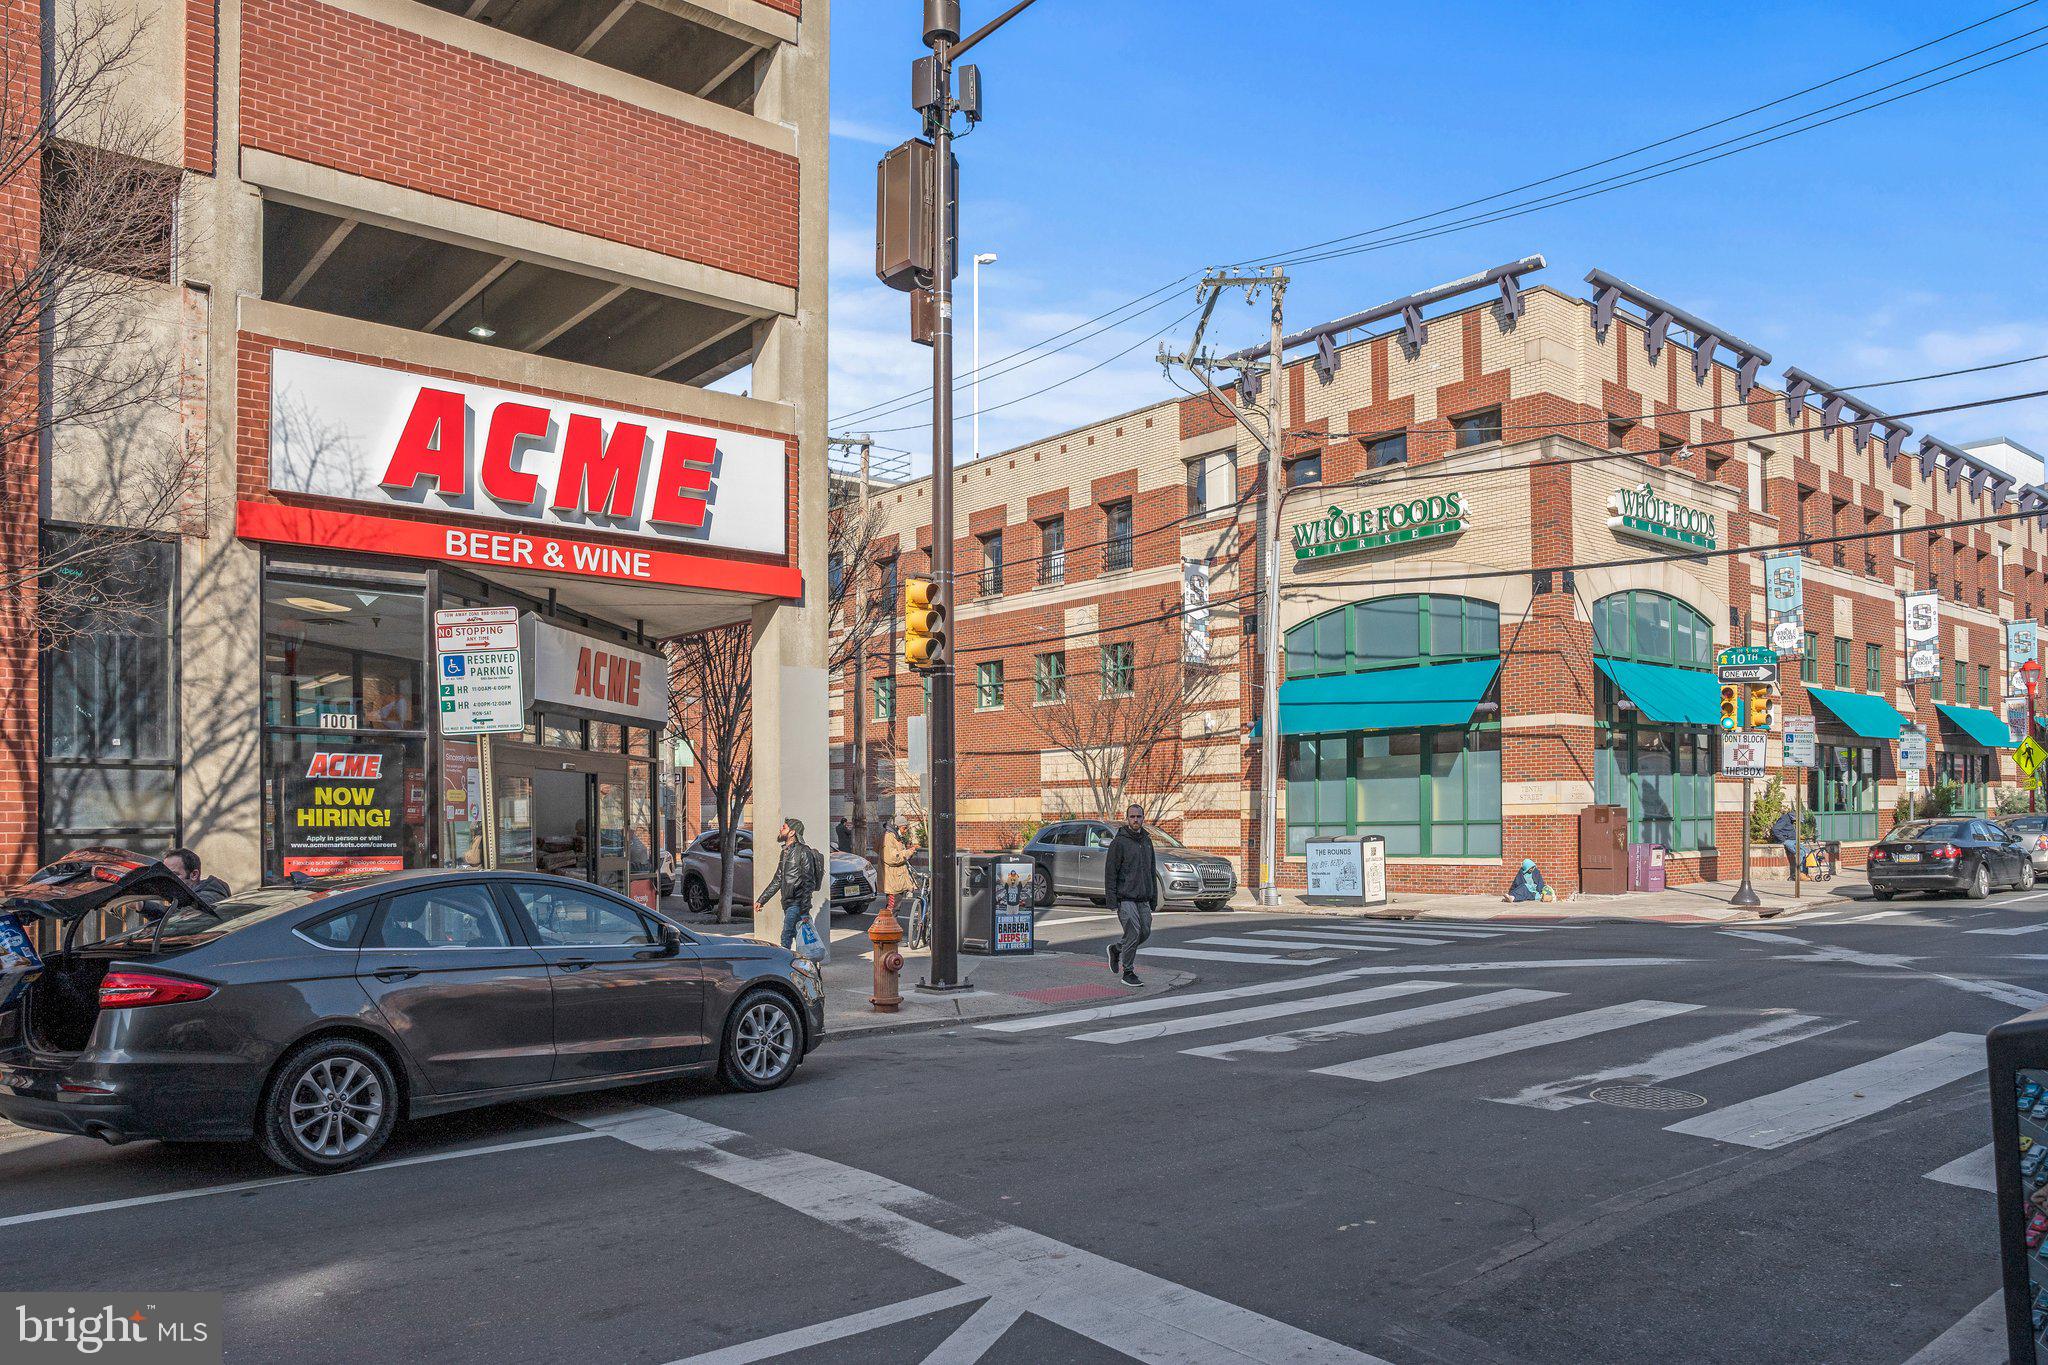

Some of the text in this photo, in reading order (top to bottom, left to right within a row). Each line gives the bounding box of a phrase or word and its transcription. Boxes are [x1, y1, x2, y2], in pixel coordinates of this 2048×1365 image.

[379, 386, 719, 529] ACME
[1616, 483, 1715, 537] WHOLE FOODS
[1293, 492, 1462, 547] WHOLE FOODS
[1308, 524, 1446, 556] MARKET
[1631, 519, 1709, 548] MARKET
[445, 530, 651, 578] BEER & WINE
[438, 626, 503, 638] NO STOPPING
[468, 654, 515, 664] RESERVED
[1731, 654, 1758, 664] 10TH
[471, 666, 513, 676] PARKING
[575, 646, 641, 706] ACME
[323, 715, 356, 728] 1001
[1743, 735, 1764, 743] BLOCK
[306, 752, 382, 779] ACME
[1726, 767, 1761, 775] THE BOX
[315, 787, 375, 806] NOW
[297, 809, 391, 827] HIRING!
[999, 923, 1029, 933] BARBERA
[999, 934, 1021, 942] JEEPS
